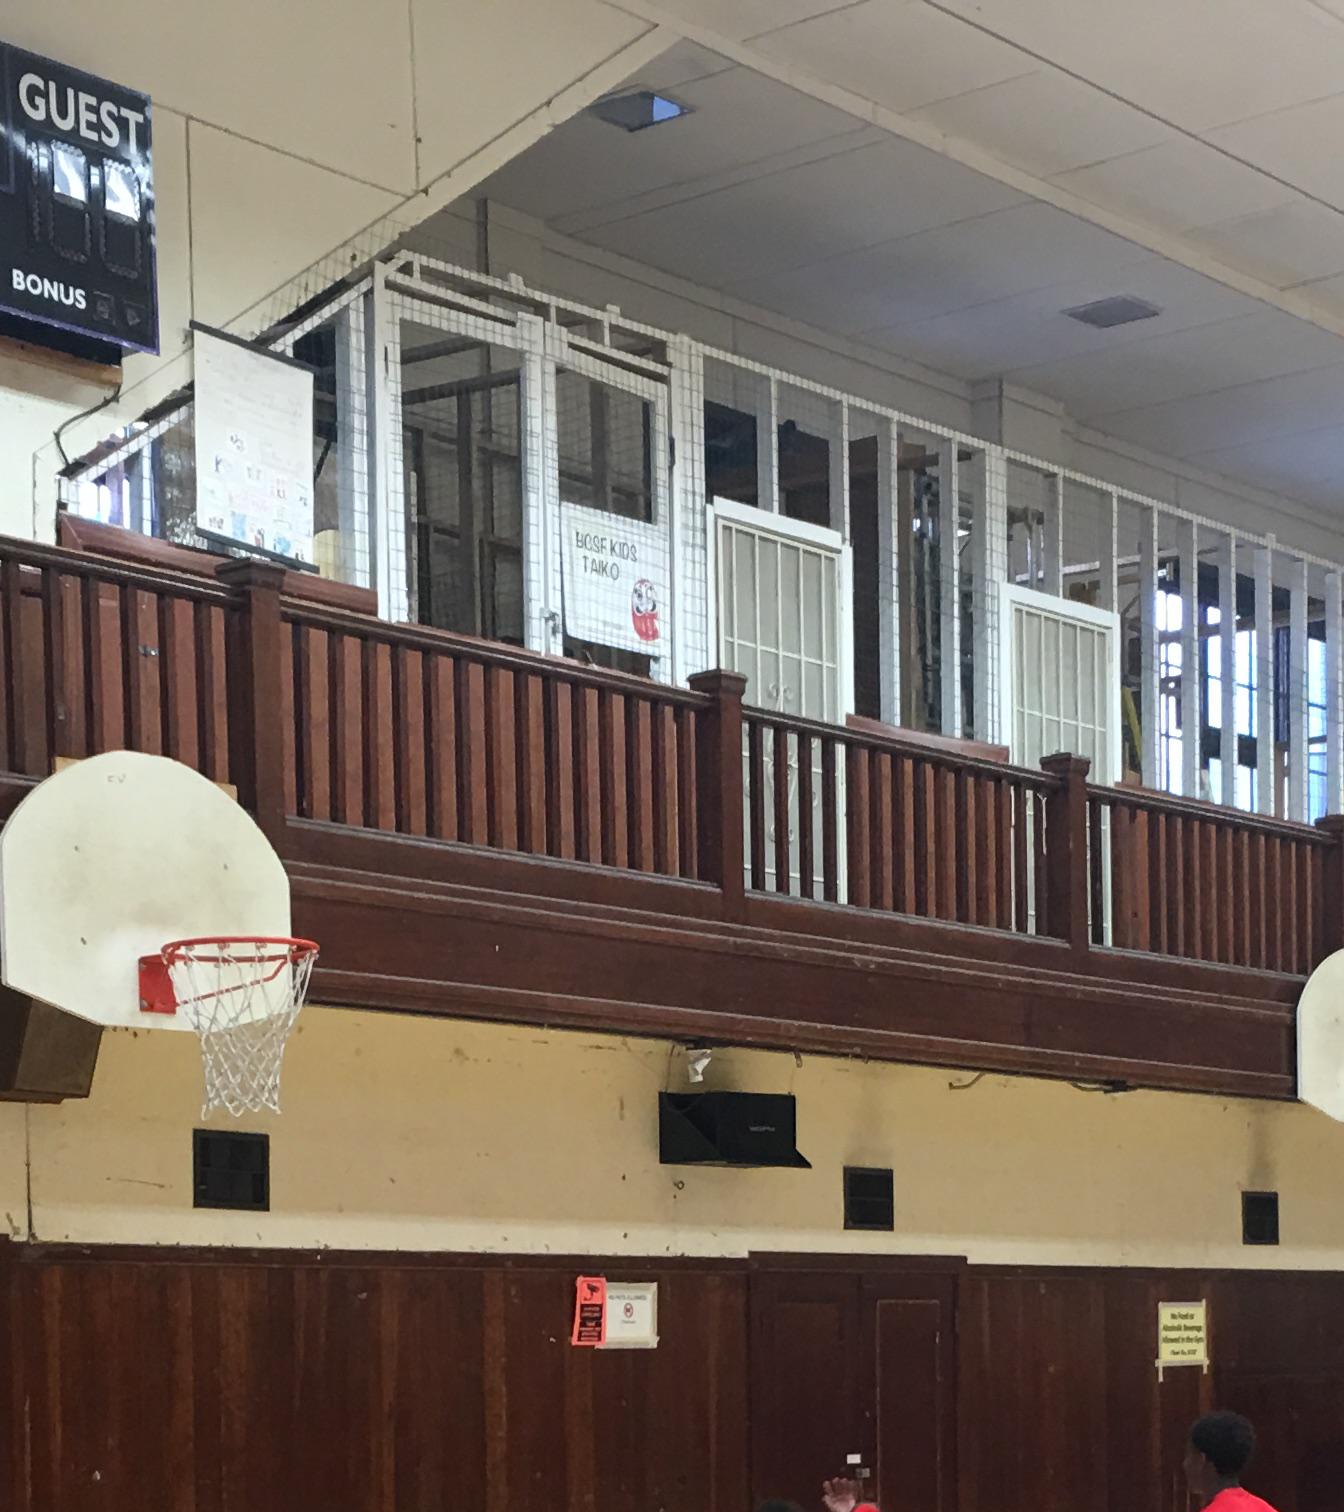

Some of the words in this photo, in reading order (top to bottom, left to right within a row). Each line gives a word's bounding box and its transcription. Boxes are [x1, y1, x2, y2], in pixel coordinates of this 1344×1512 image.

[19, 72, 145, 155] GUEST
[11, 268, 87, 310] BONUS
[610, 539, 638, 562] KIDS
[582, 555, 620, 581] TAIKO
